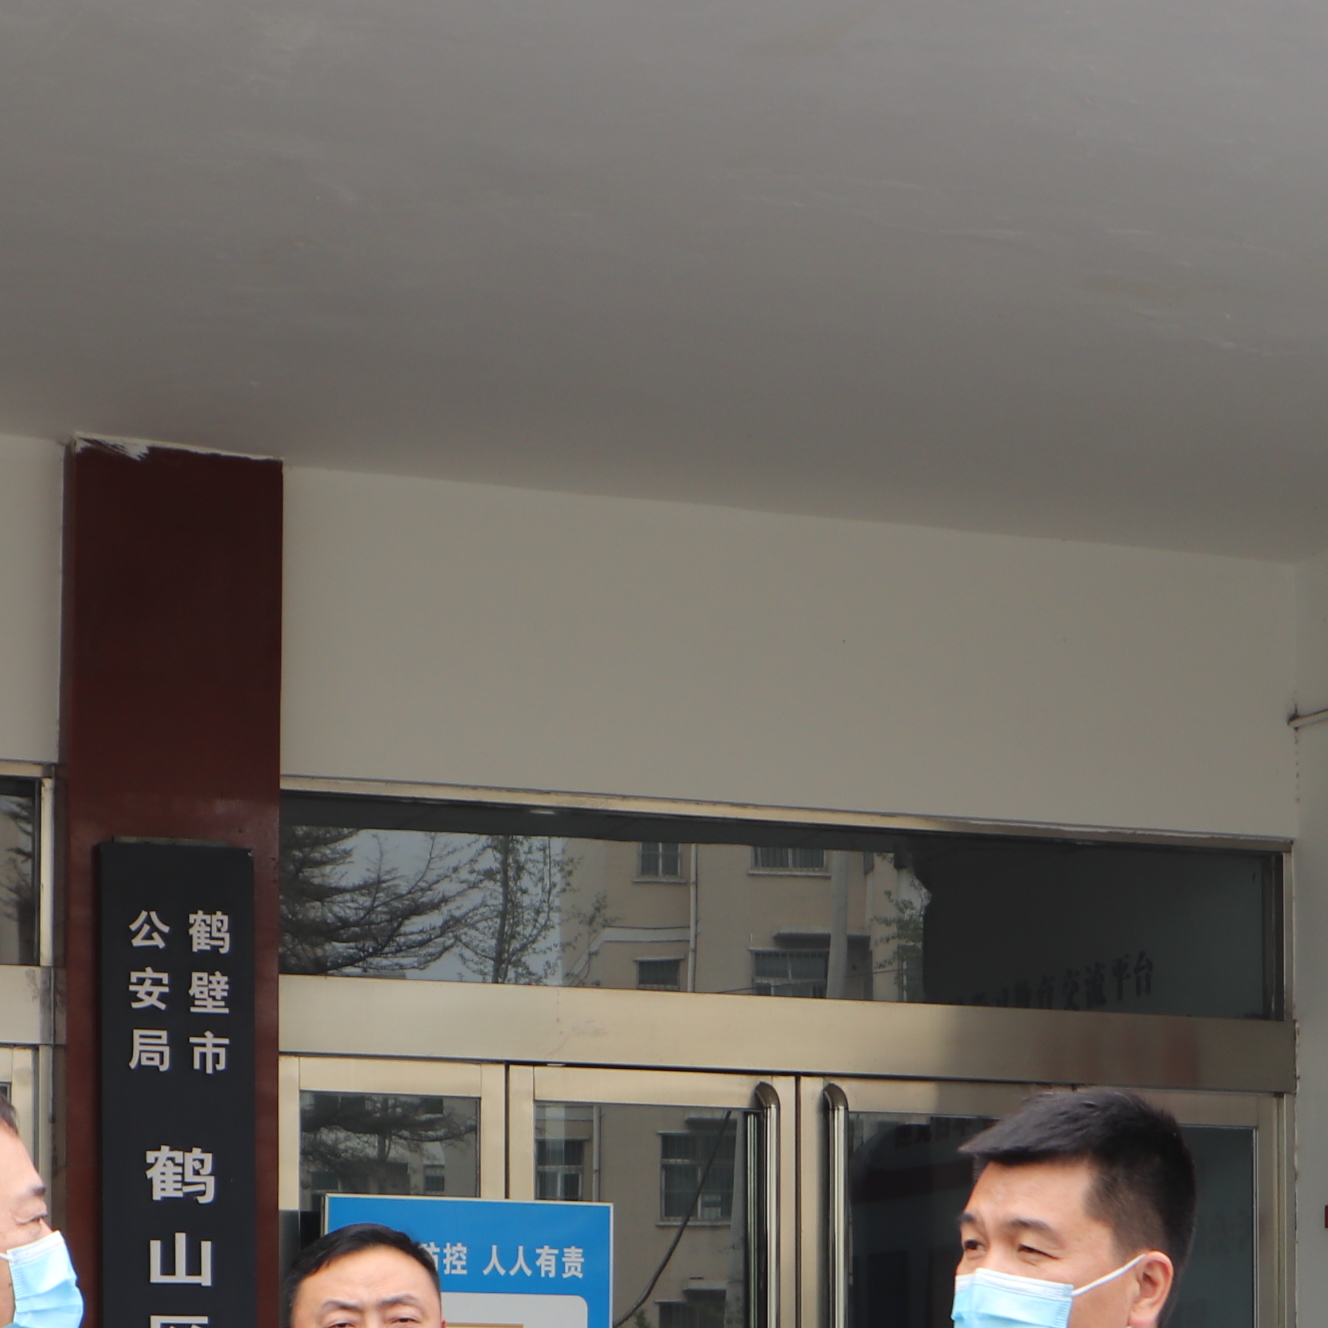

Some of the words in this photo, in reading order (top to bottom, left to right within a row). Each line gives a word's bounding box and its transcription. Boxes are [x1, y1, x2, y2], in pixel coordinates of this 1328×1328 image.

[129, 910, 170, 1072] 公安局
[189, 909, 230, 1074] 鹤壁市
[482, 1245, 585, 1278] 人人有责
